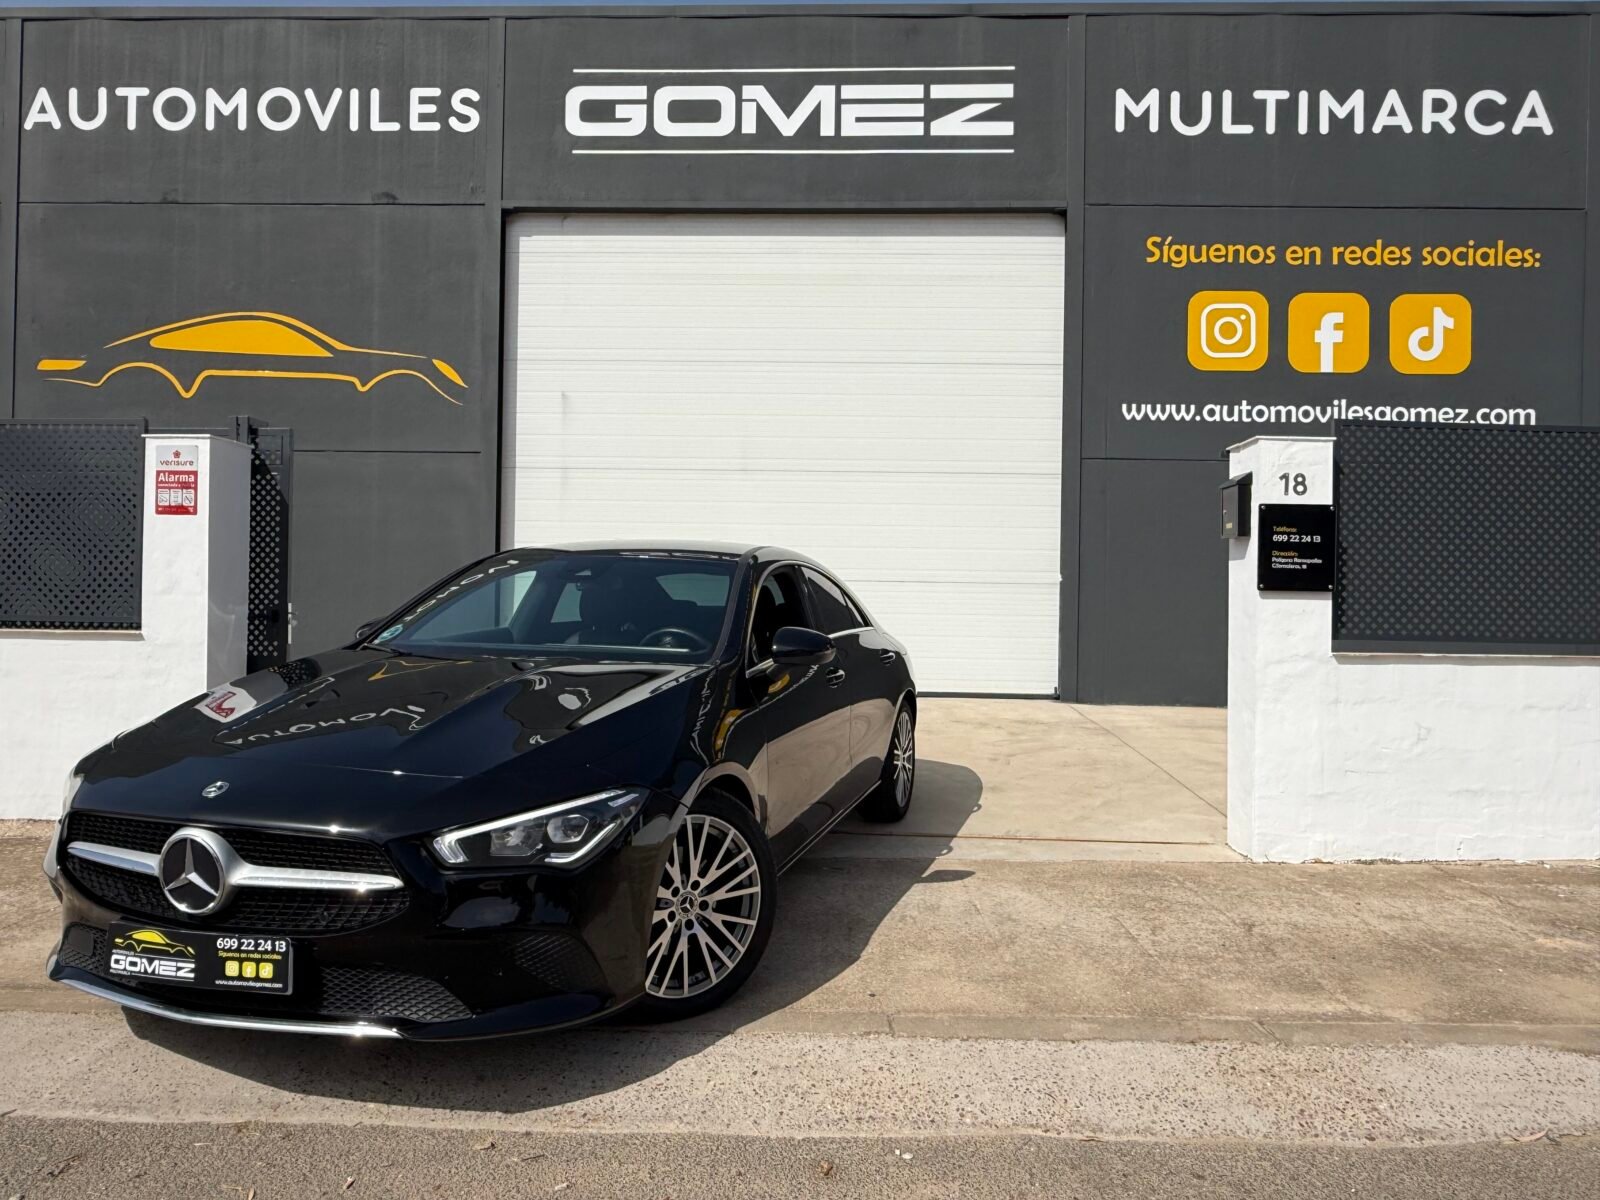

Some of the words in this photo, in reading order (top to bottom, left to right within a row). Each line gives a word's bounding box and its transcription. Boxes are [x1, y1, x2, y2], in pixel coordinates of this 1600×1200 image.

[24, 87, 480, 133] AUTOMOVILES
[565, 83, 1014, 137] GOMEZ
[1115, 87, 1554, 136] MULTIMARCA
[1145, 236, 1276, 268] Síguenos
[1285, 244, 1321, 265] en
[1332, 239, 1412, 266] redes
[1421, 239, 1542, 268] sociales:
[158, 472, 195, 482] Alarma
[1278, 472, 1308, 496] 18
[1272, 534, 1288, 542] 699
[1289, 534, 1300, 542] 22
[1300, 535, 1311, 543] 24
[216, 937, 238, 950] 699
[240, 938, 255, 950] 22
[257, 939, 272, 952] 24
[275, 940, 286, 952] 13
[110, 954, 195, 978] GOMEZ
